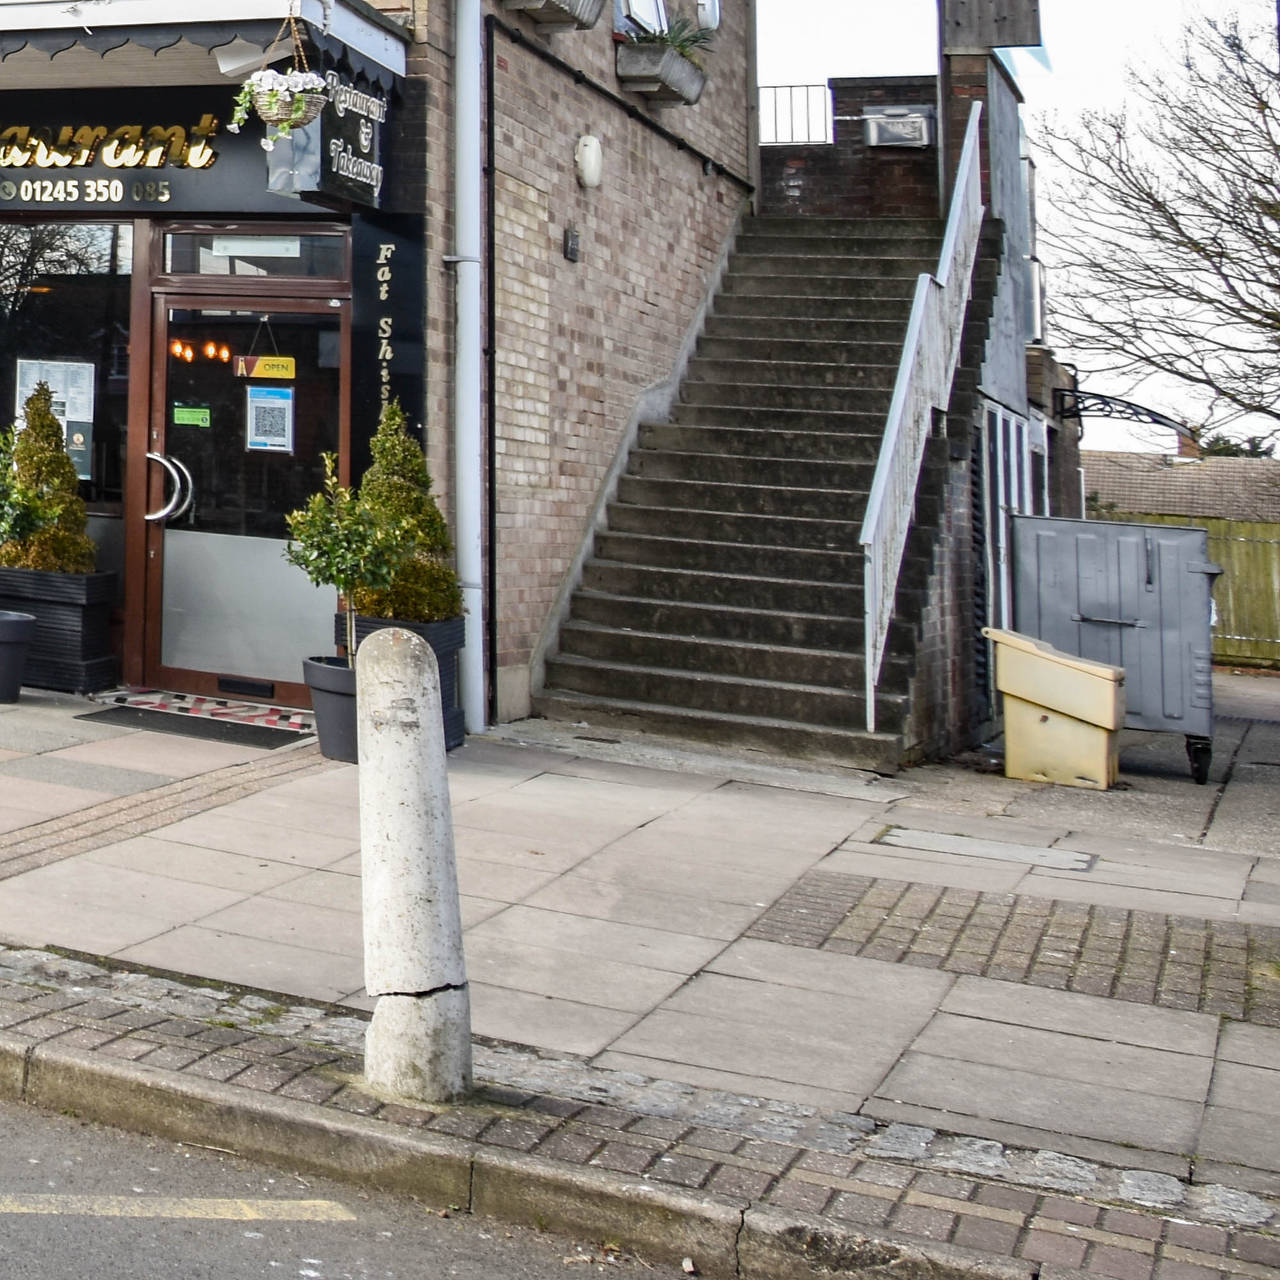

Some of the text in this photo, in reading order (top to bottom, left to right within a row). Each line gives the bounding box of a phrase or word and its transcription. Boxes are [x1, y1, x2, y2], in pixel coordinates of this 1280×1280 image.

[325, 70, 387, 123] Restaurant
[359, 119, 373, 153] &
[329, 138, 383, 197] Takeaway
[20, 179, 170, 202] 01245 350 085
[376, 244, 395, 300] Fat
[263, 363, 289, 372] OPEN
